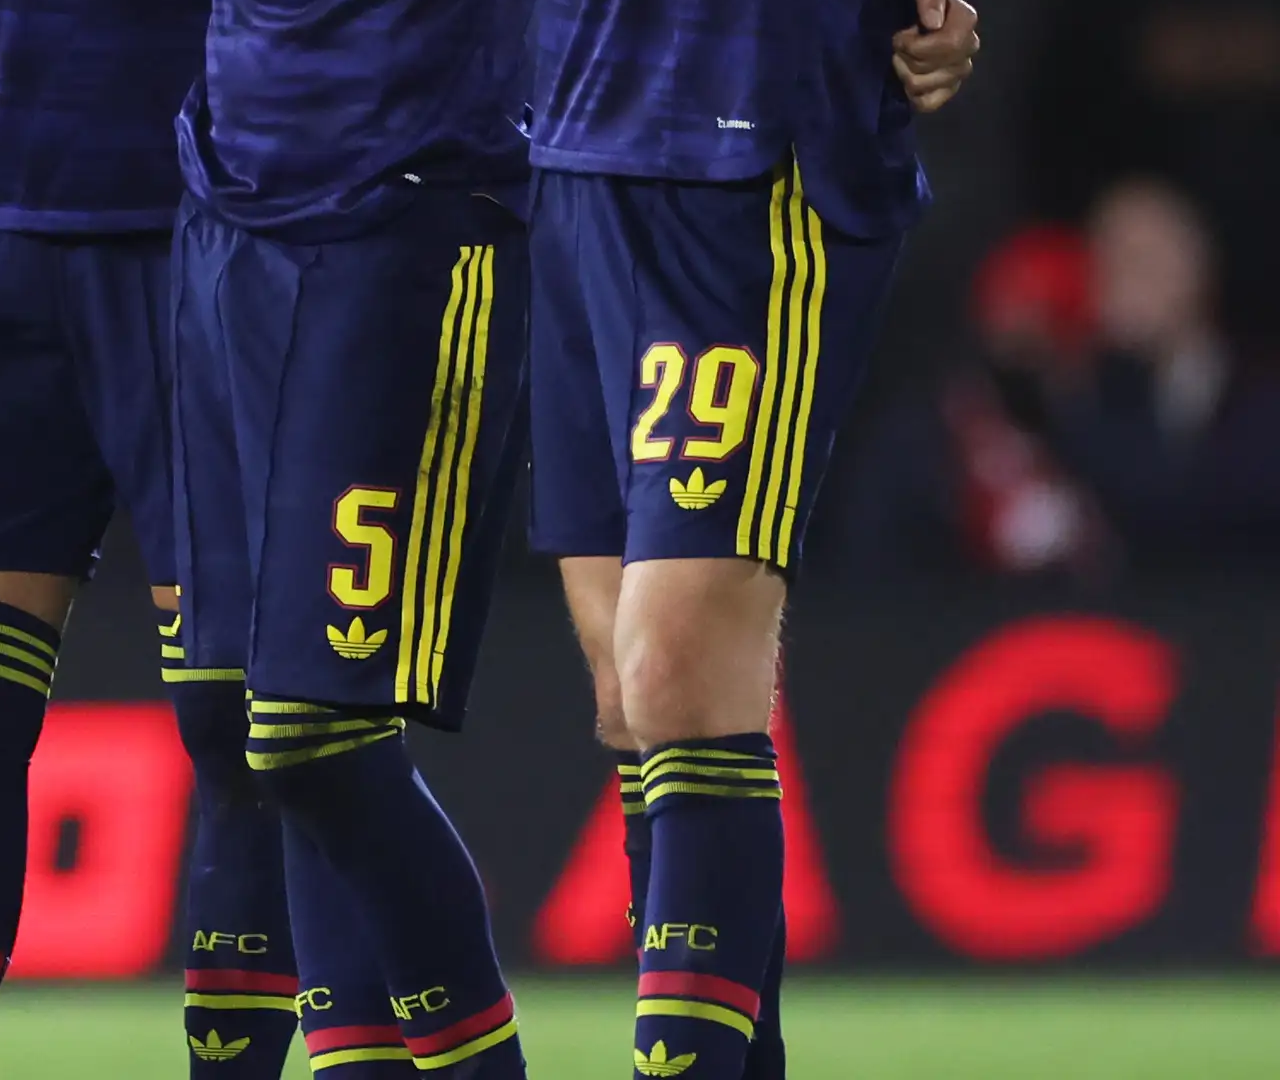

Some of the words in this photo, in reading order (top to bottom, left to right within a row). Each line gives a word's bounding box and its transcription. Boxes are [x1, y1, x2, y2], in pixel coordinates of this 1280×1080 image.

[630, 341, 758, 463] 29
[327, 484, 400, 610] 5
[192, 929, 268, 954] AFC
[644, 922, 718, 953] AFC
[293, 986, 333, 1019] FC
[390, 986, 450, 1020] AFC
